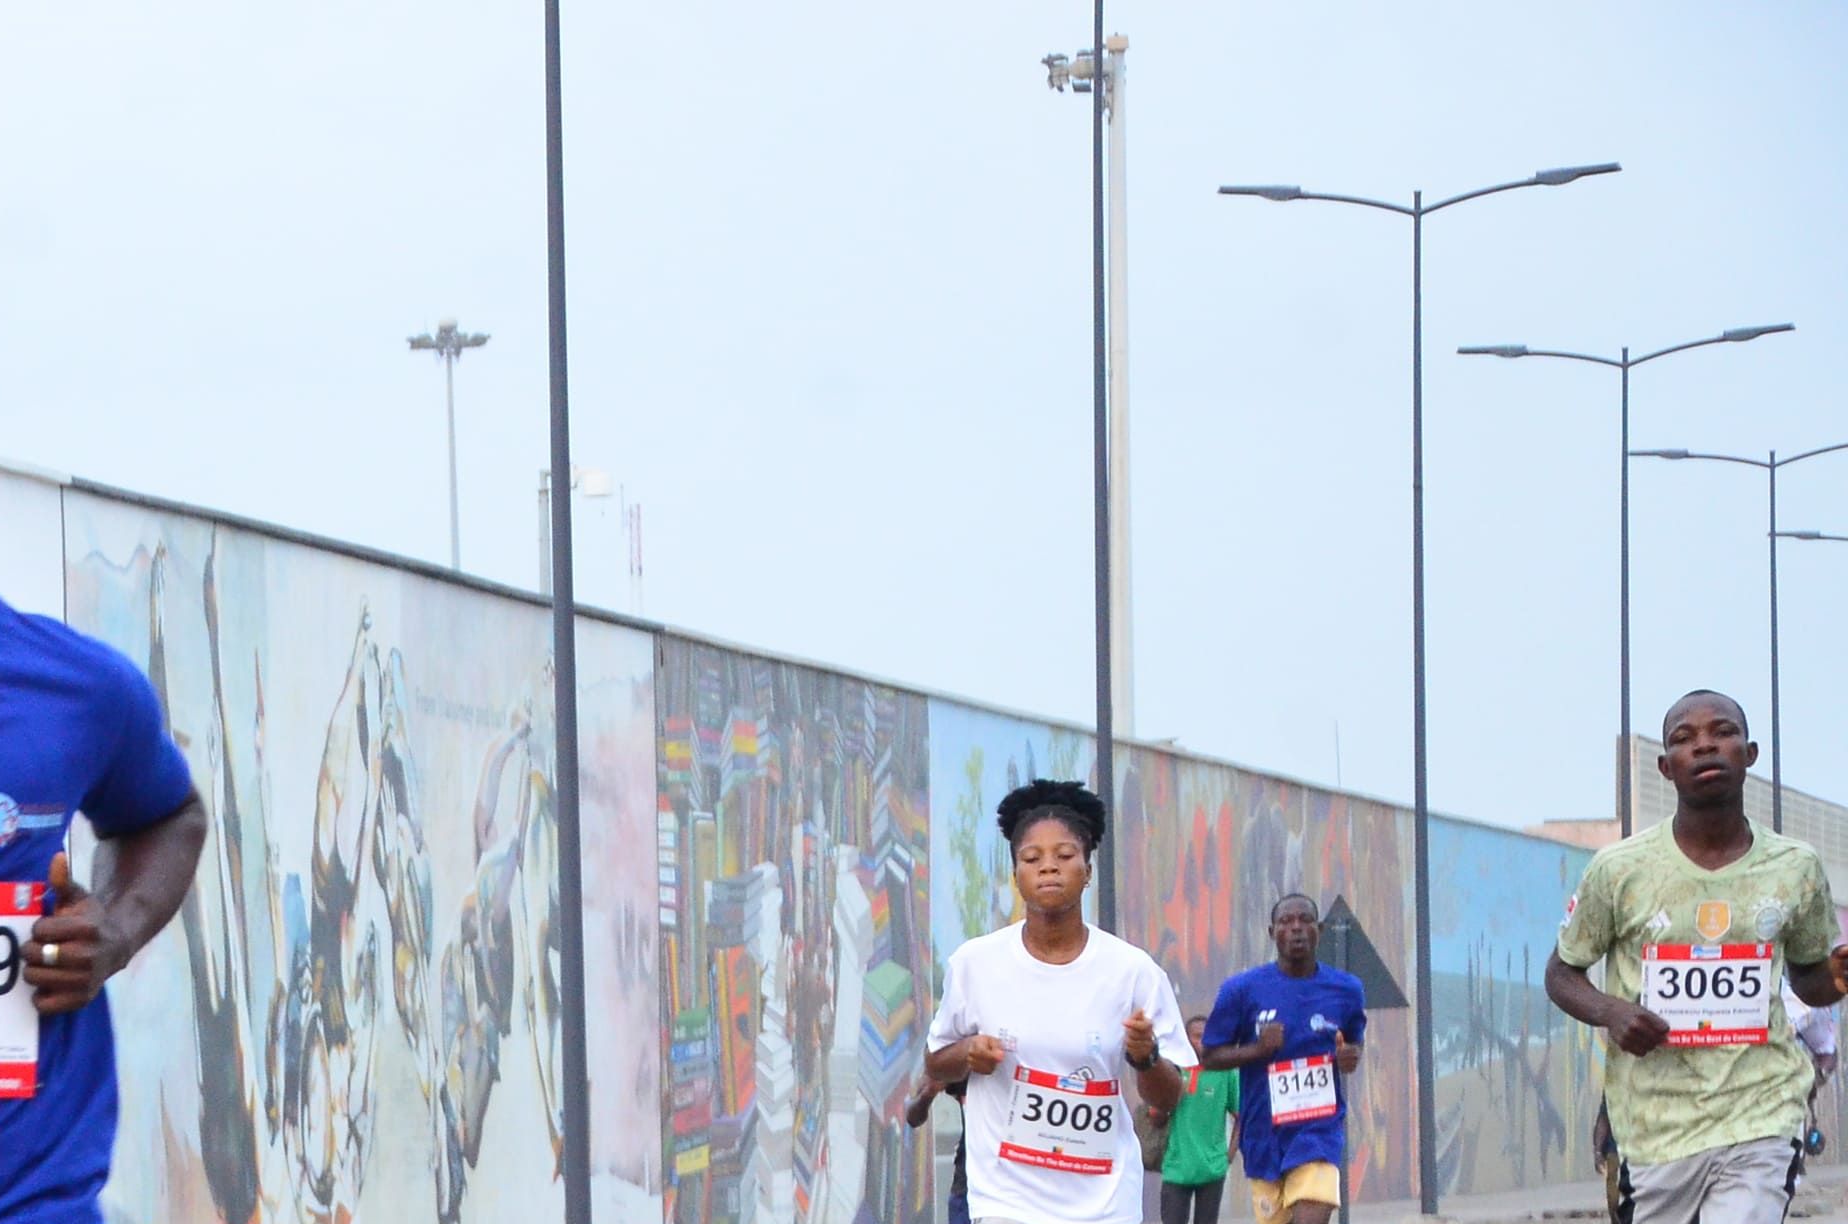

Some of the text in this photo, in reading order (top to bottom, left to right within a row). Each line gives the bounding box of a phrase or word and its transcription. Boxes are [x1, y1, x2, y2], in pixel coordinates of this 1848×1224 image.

[1658, 966, 1762, 999] 3065
[1278, 1068, 1329, 1095] 3143
[1022, 1093, 1113, 1133] 3008
